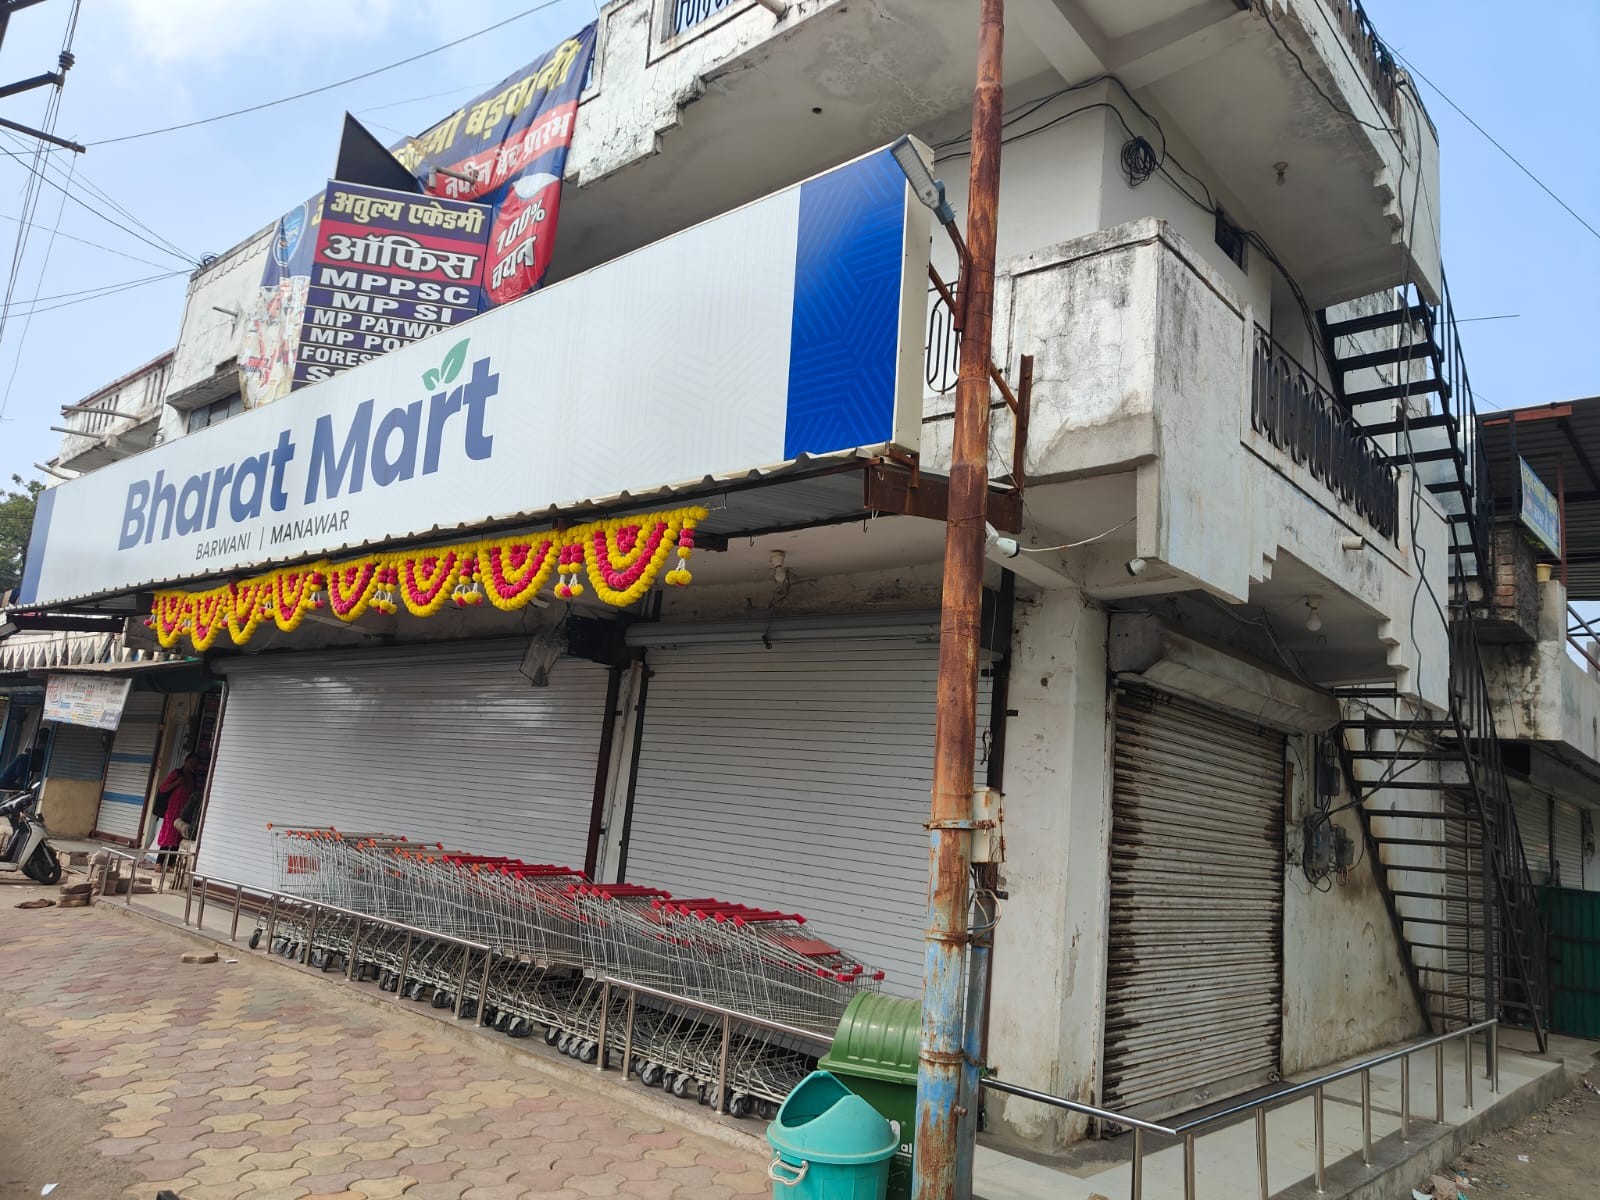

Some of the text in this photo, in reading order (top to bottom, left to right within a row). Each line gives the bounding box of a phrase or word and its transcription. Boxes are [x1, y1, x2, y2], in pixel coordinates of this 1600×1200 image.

[330, 191, 404, 223] अतुल्य
[408, 201, 485, 234] एकेडमी
[496, 199, 546, 255] 100%
[323, 233, 479, 279] ऑफिस
[492, 235, 537, 290] चयन
[320, 267, 470, 304] MPPSC
[312, 308, 447, 339] MP PATWA
[332, 292, 453, 323] MP SI
[301, 346, 382, 365] FORES
[309, 328, 355, 345] MP
[118, 356, 500, 550] Bharat Mart
[195, 510, 349, 560] BARWANI MANAWAR
